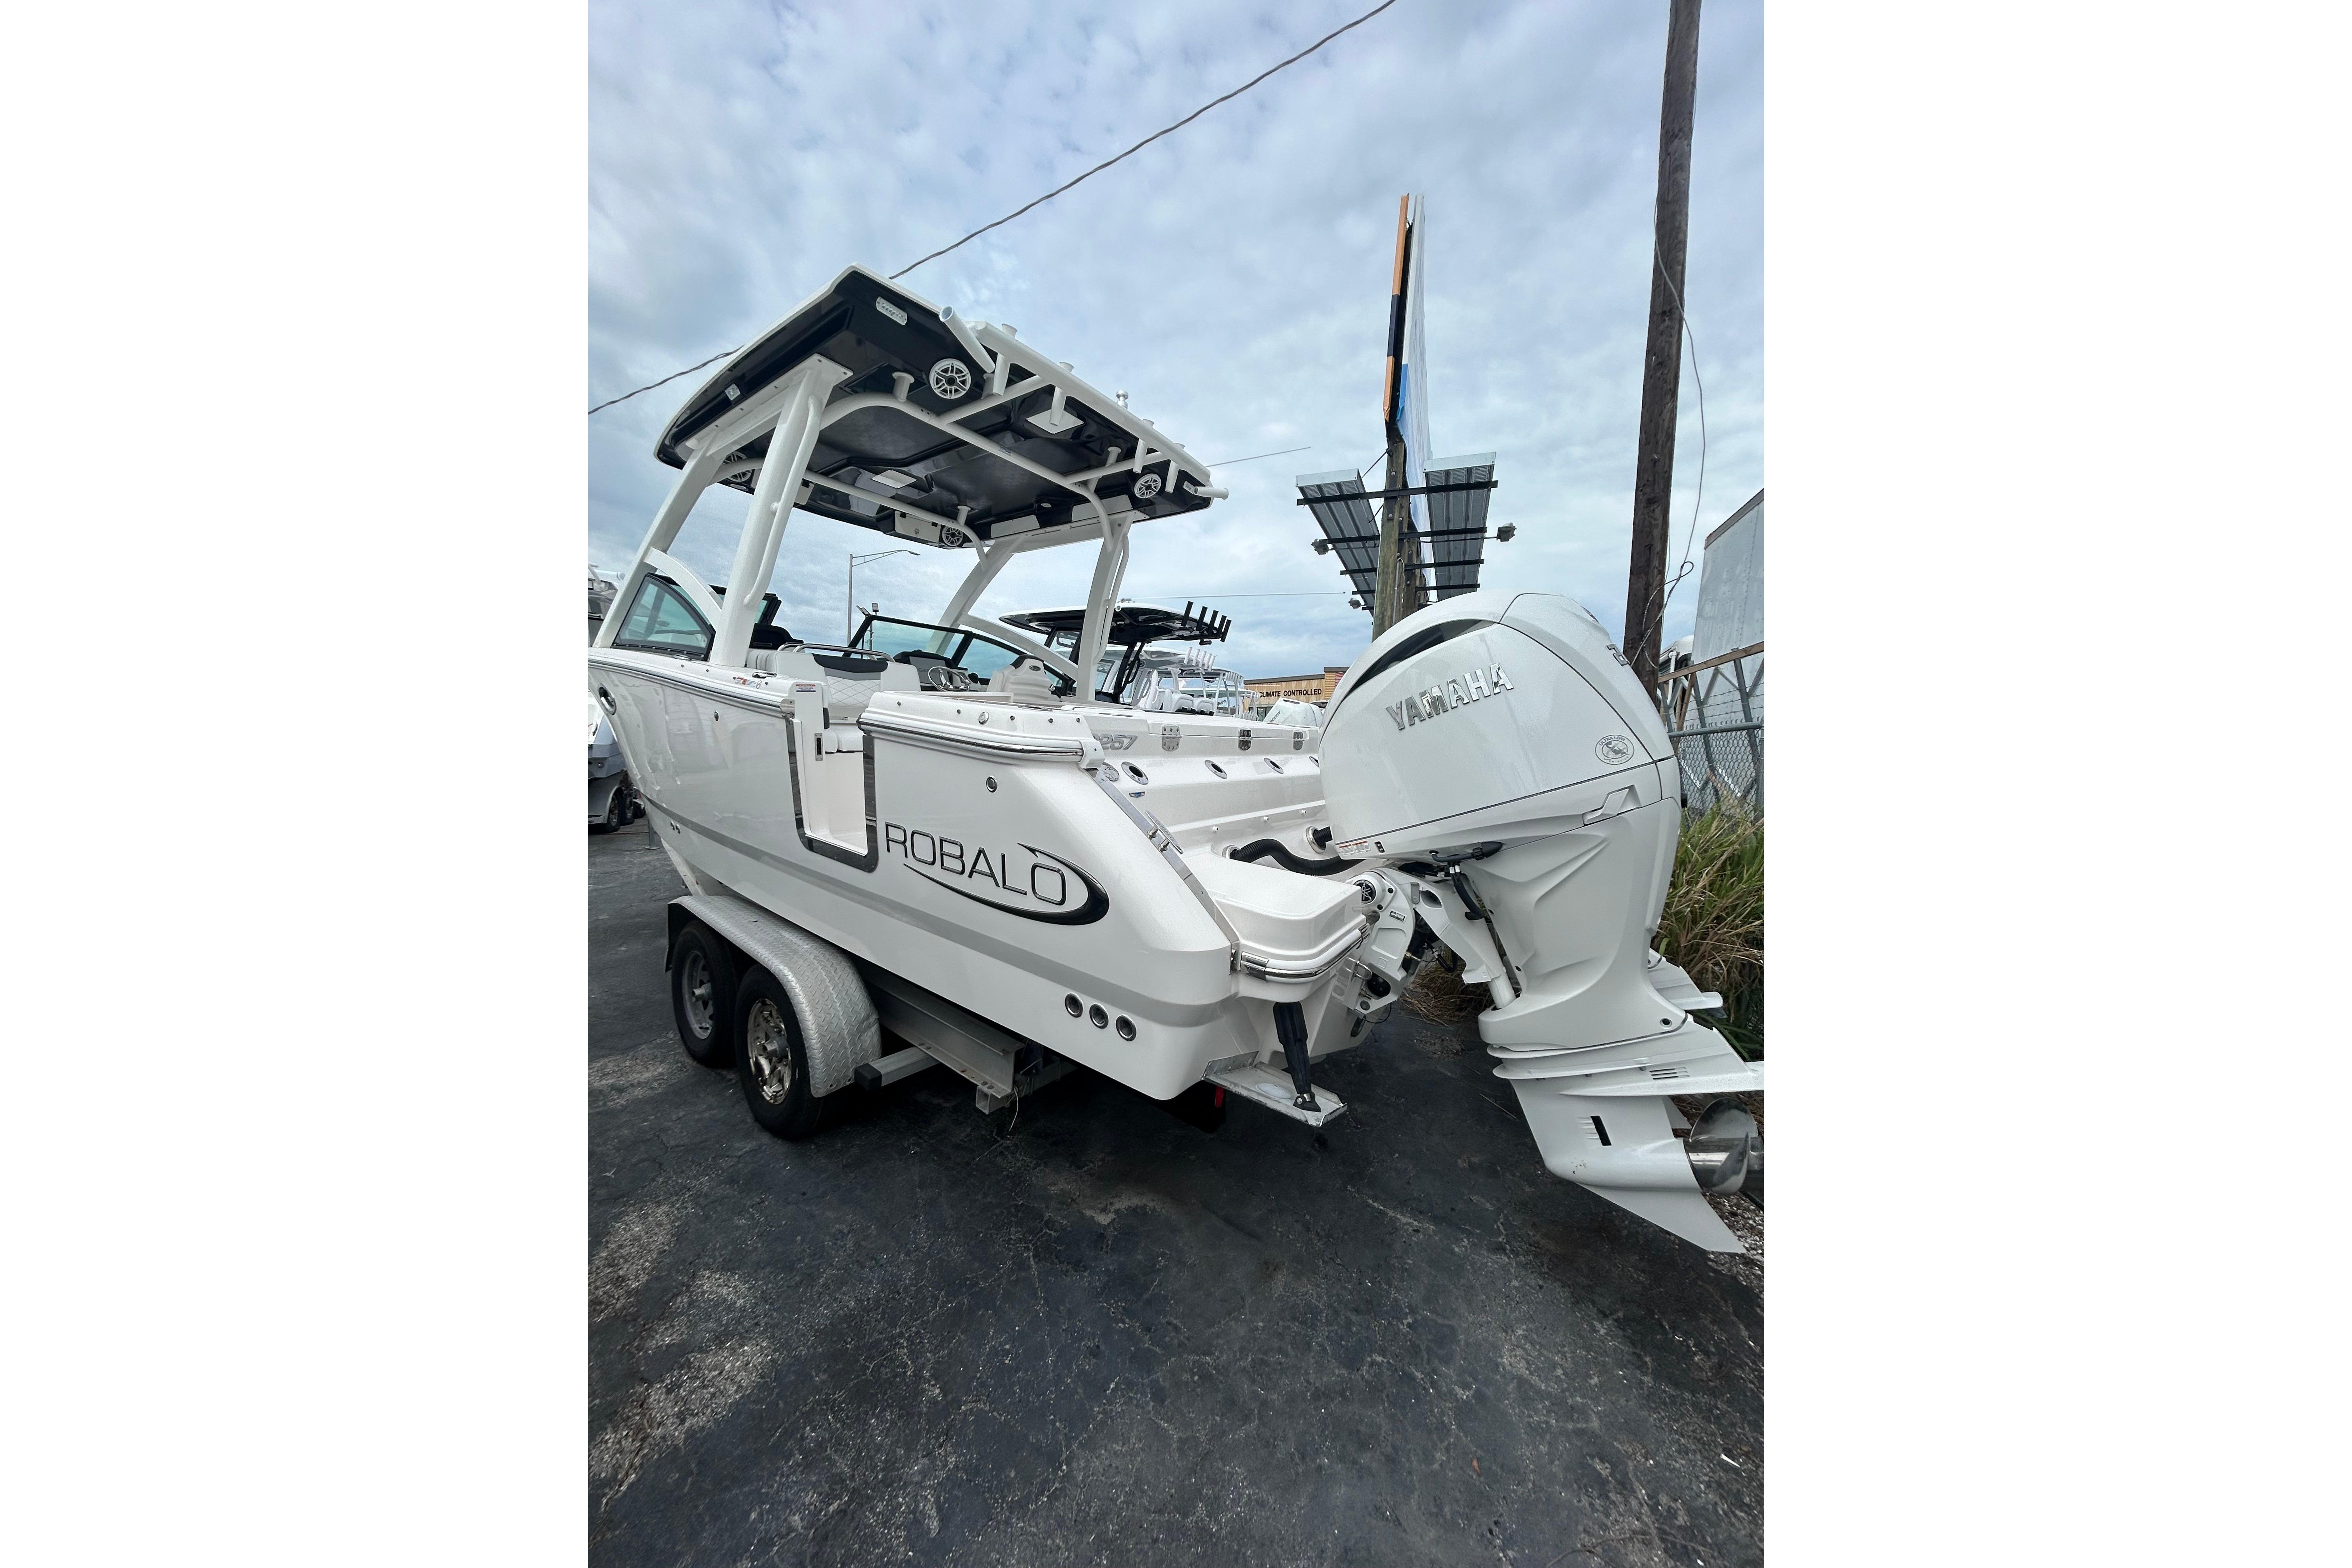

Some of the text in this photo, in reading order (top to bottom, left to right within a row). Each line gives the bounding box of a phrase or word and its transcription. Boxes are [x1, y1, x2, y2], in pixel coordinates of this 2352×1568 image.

[1283, 688, 1322, 696] CONTROLLED
[1385, 662, 1514, 731] YAMAHA
[885, 821, 1066, 906] ROBALO
